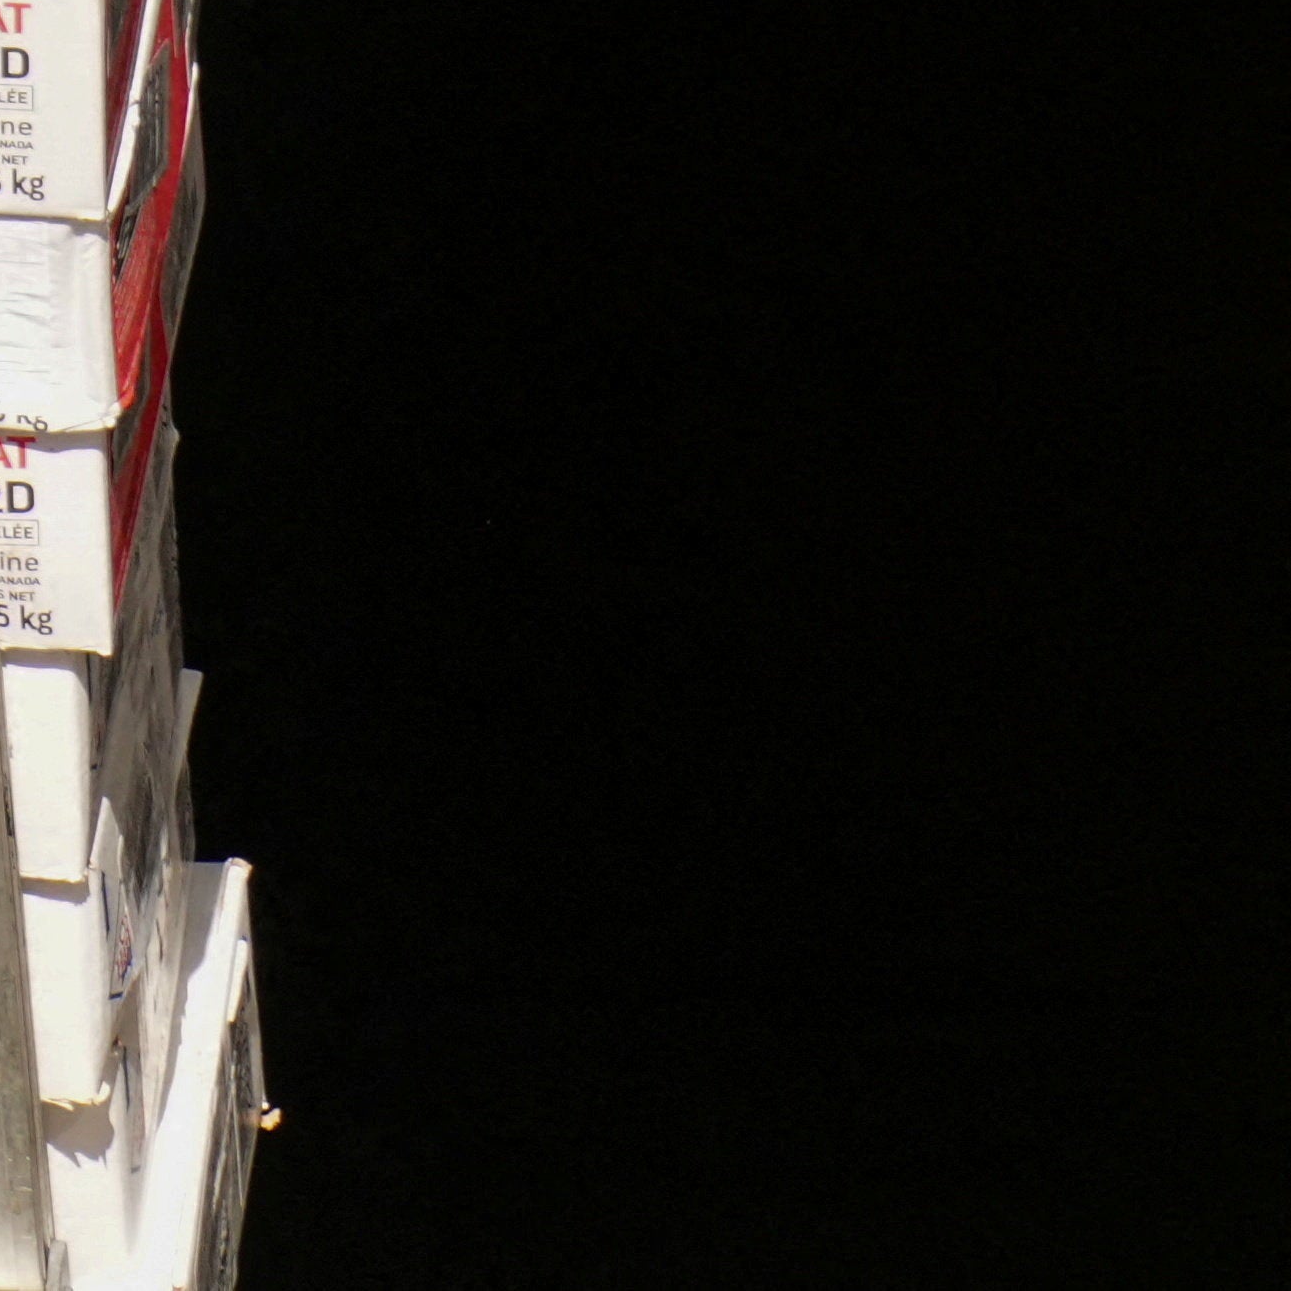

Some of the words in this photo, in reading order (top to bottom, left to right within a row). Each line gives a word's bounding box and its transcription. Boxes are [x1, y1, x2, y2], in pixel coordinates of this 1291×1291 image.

[2, 155, 28, 166] NET
[12, 169, 45, 201] kg
[9, 591, 36, 602] NET
[21, 605, 54, 636] kg
